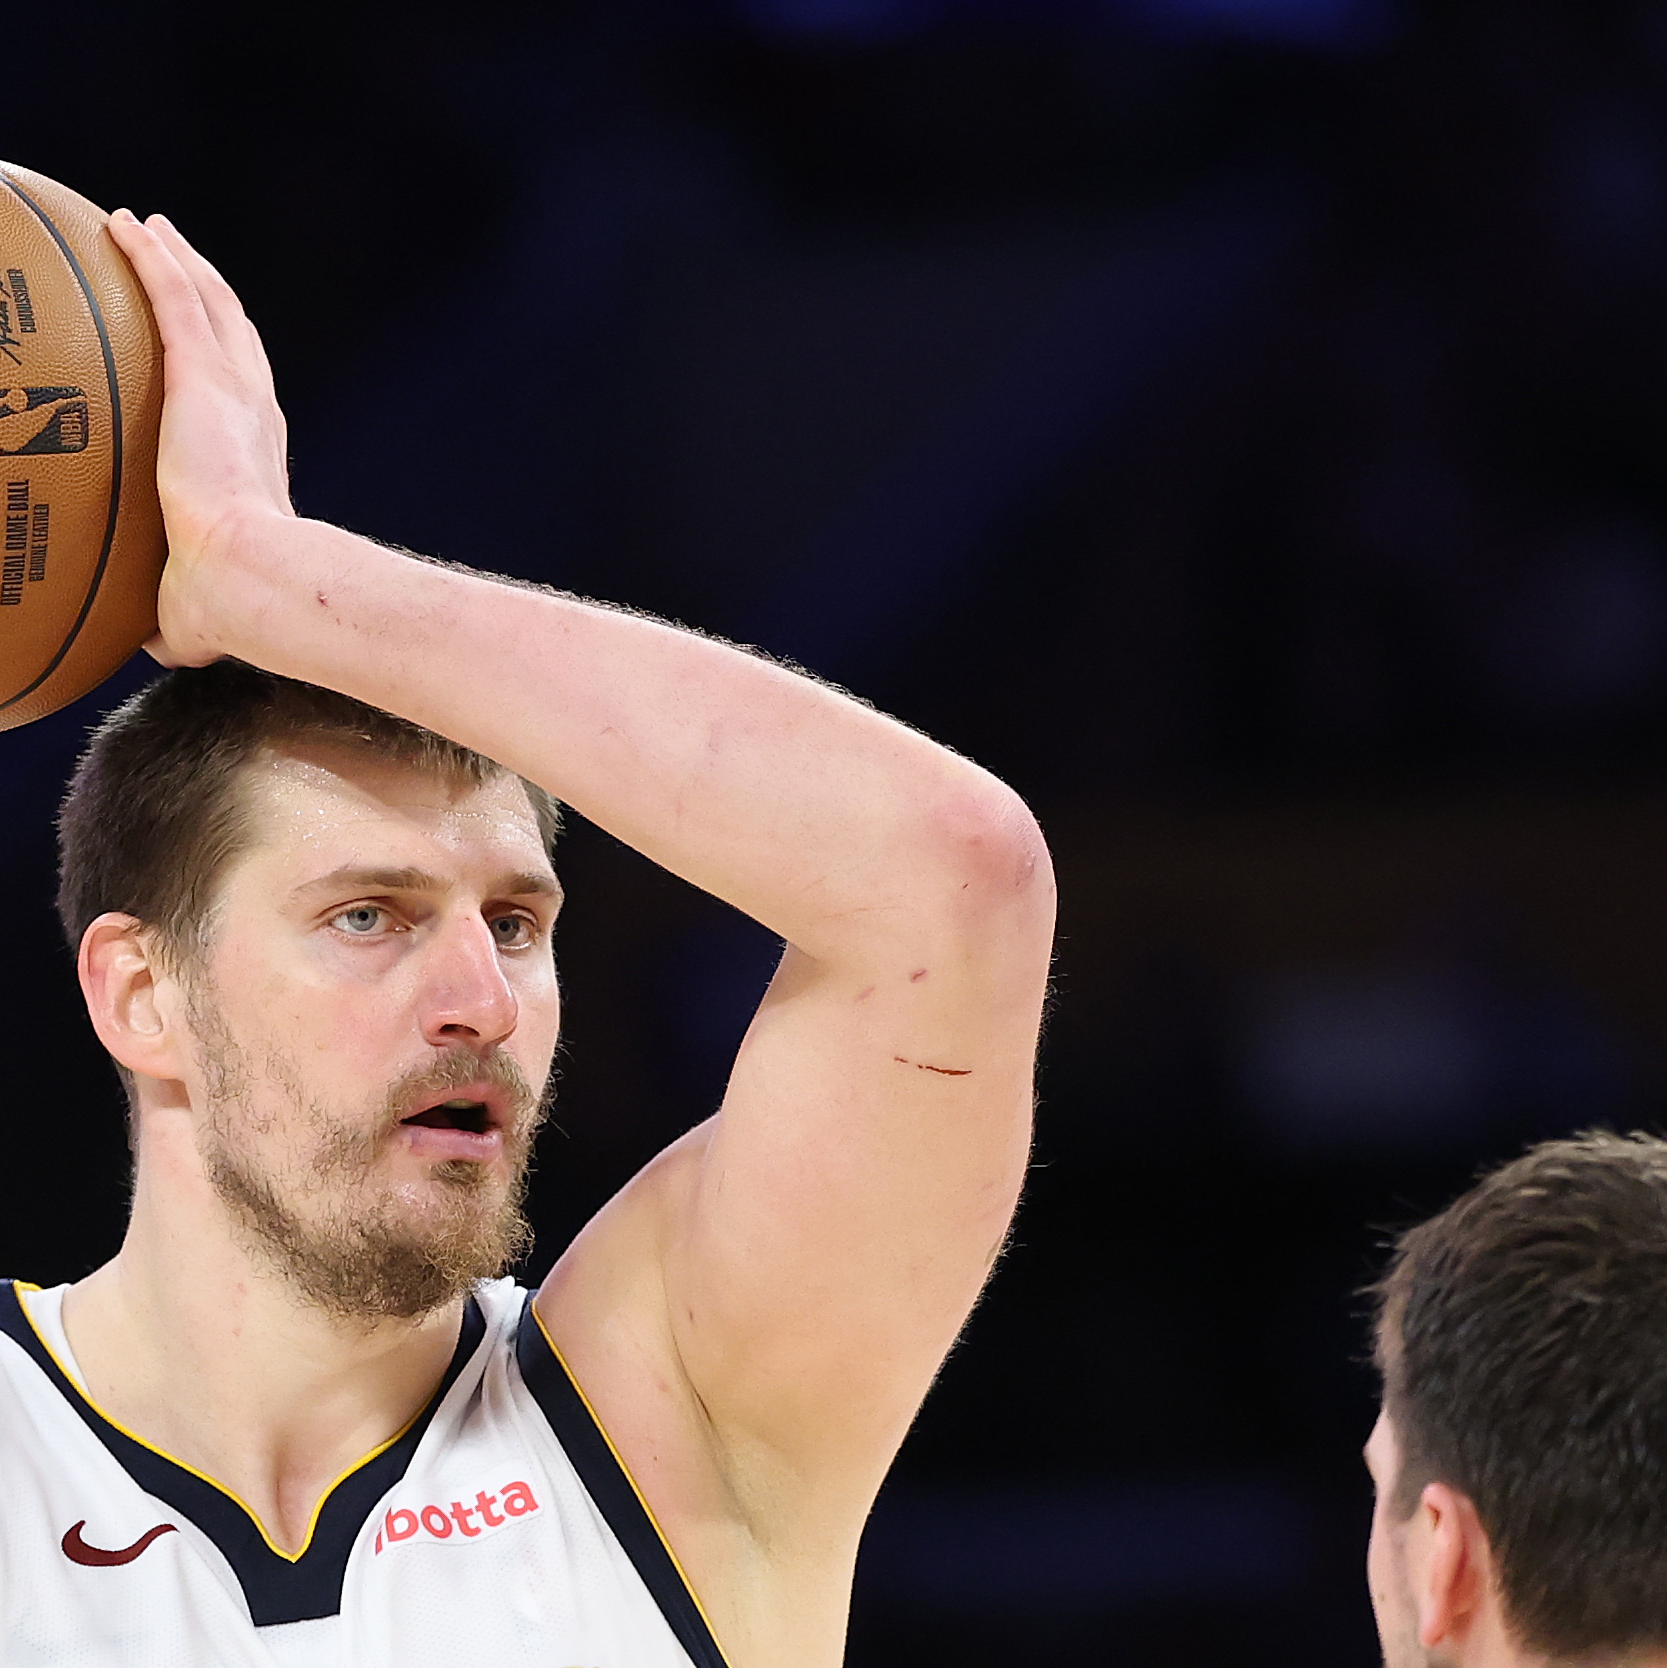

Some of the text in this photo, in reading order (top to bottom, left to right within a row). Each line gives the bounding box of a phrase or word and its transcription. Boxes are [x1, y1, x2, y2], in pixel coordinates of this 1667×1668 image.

[59, 410, 84, 447] NBA
[7, 478, 30, 511] BALL
[0, 553, 26, 606] OFFICIAL
